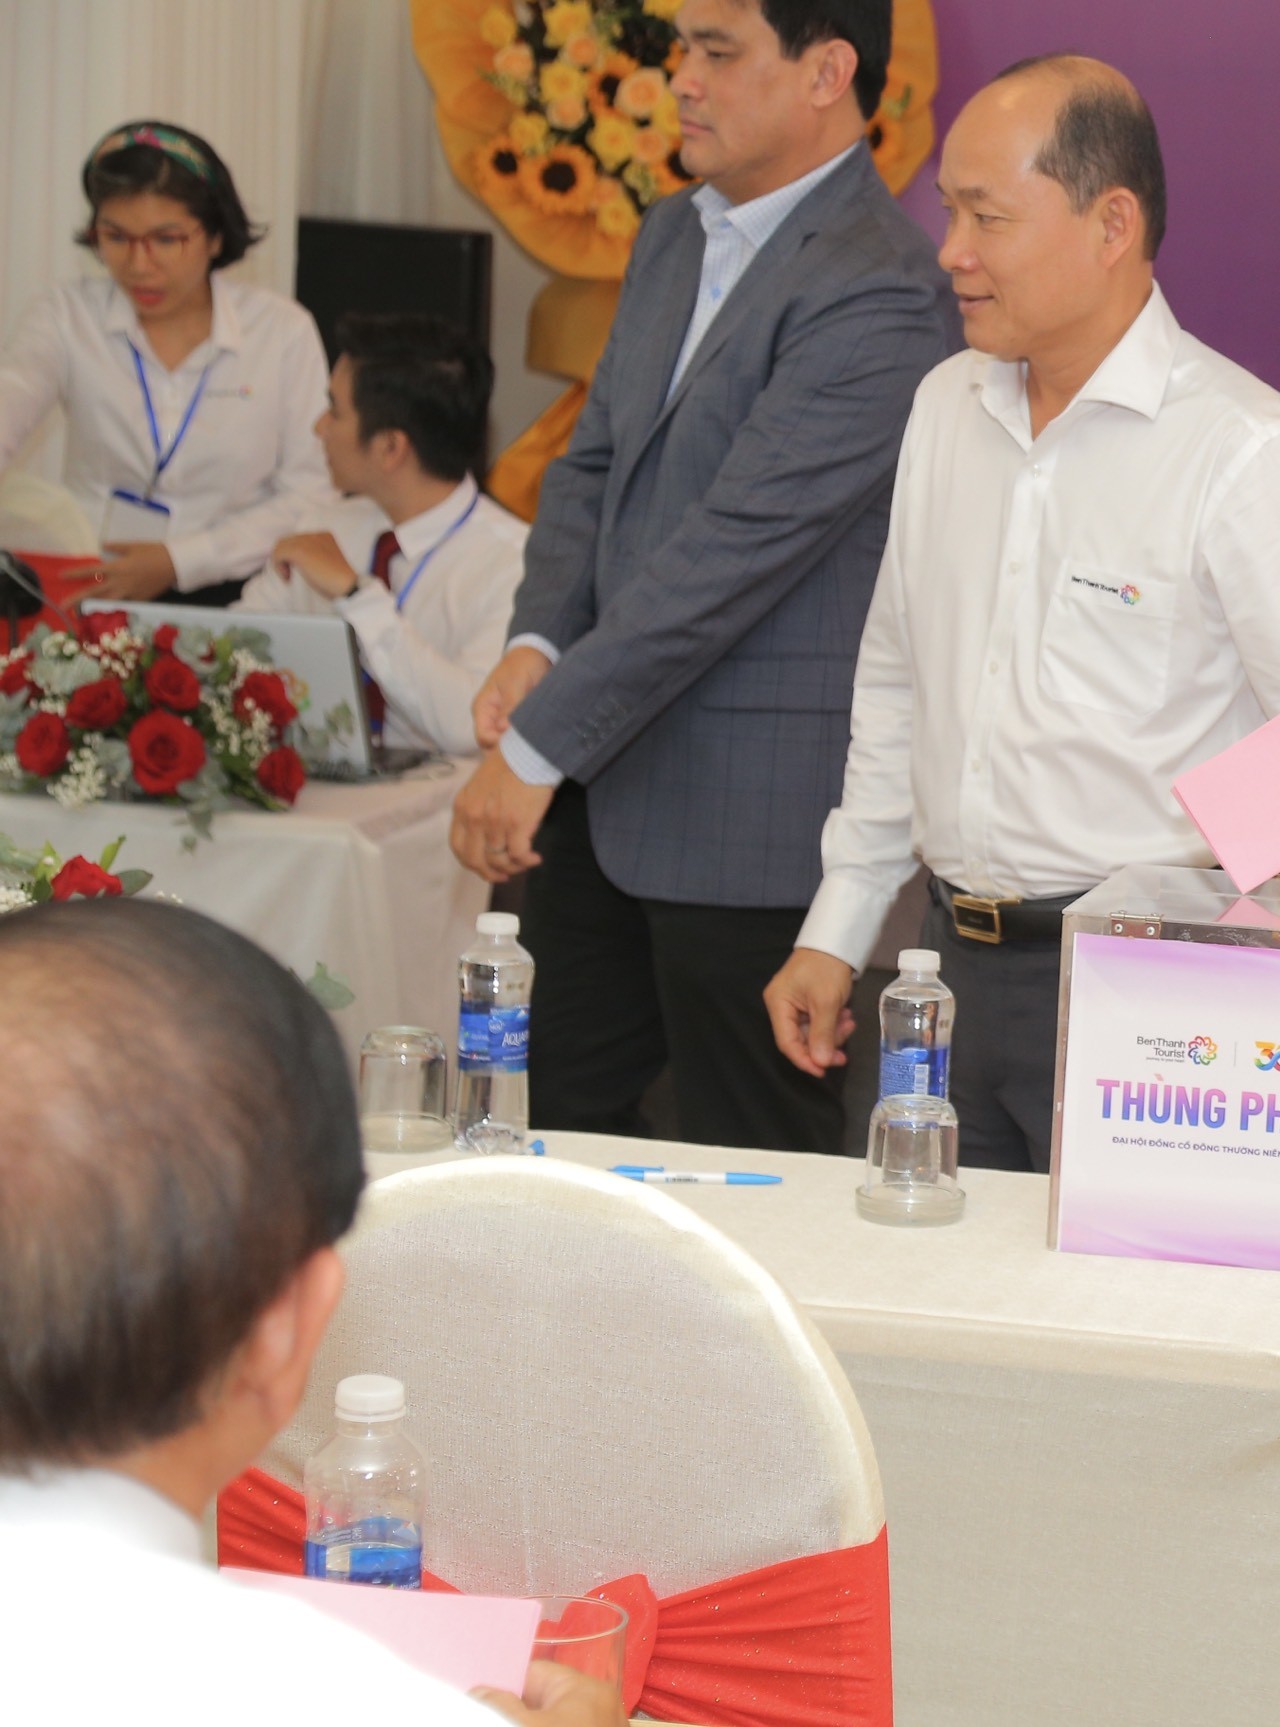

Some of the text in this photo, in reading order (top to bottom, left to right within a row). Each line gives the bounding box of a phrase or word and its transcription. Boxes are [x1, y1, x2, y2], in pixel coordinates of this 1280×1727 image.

[1154, 1047, 1186, 1059] Tourist
[1096, 1073, 1227, 1129] THÙNG
[1112, 1136, 1128, 1146] ĐẠI
[1130, 1137, 1147, 1148] HỘI
[1192, 1143, 1220, 1153] ĐÔNG
